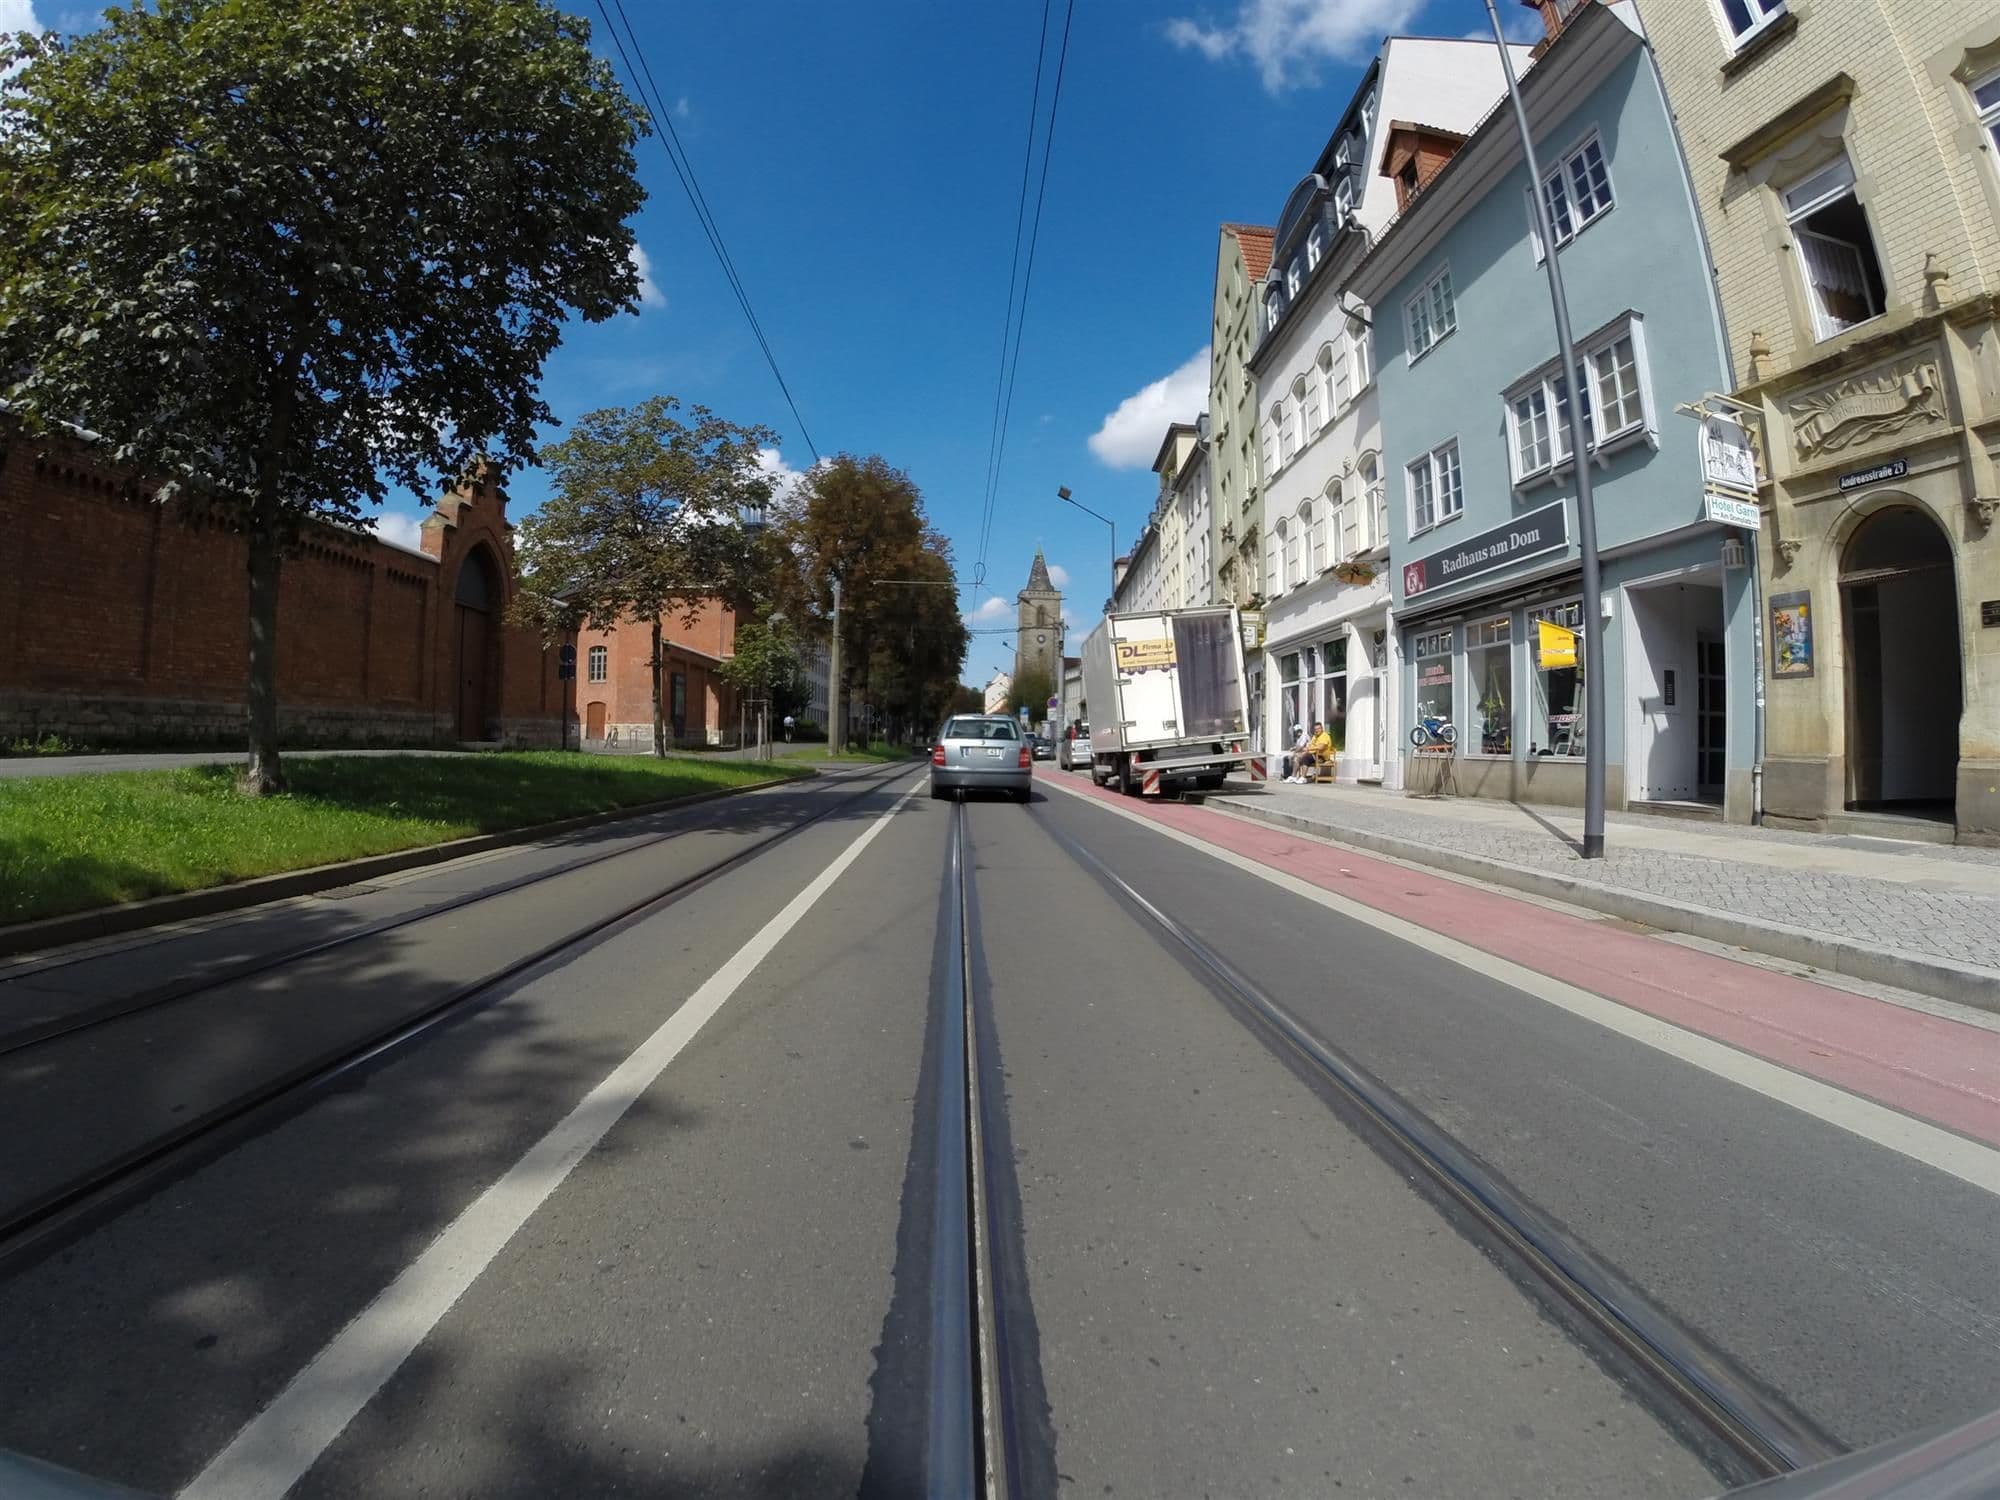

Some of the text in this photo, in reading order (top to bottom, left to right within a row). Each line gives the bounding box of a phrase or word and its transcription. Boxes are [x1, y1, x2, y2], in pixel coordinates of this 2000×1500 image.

[1841, 467, 1893, 488] Andreasstraße
[1711, 498, 1734, 513] Hotel
[1441, 528, 1541, 574] Radhaus am Dom
